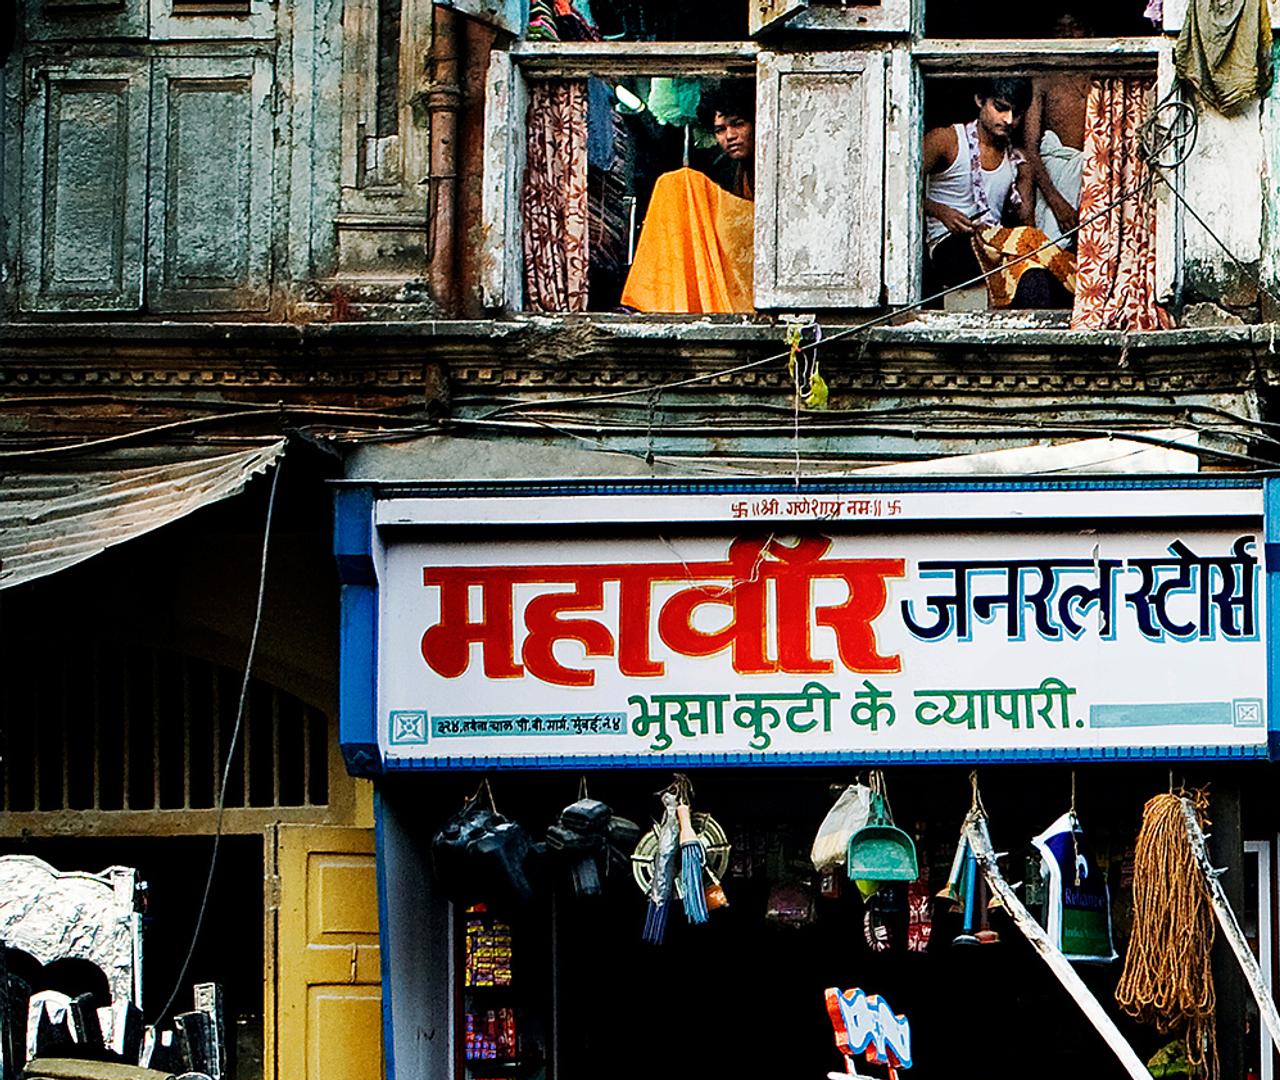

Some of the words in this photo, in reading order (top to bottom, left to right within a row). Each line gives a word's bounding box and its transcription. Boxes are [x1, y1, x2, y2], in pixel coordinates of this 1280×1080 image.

[420, 535, 906, 686] महावीर
[900, 558, 1123, 643] जनरल
[1125, 535, 1262, 643] स्टोर्स
[628, 692, 730, 751] भुसा
[732, 681, 840, 750] कुटी
[850, 681, 896, 731] के
